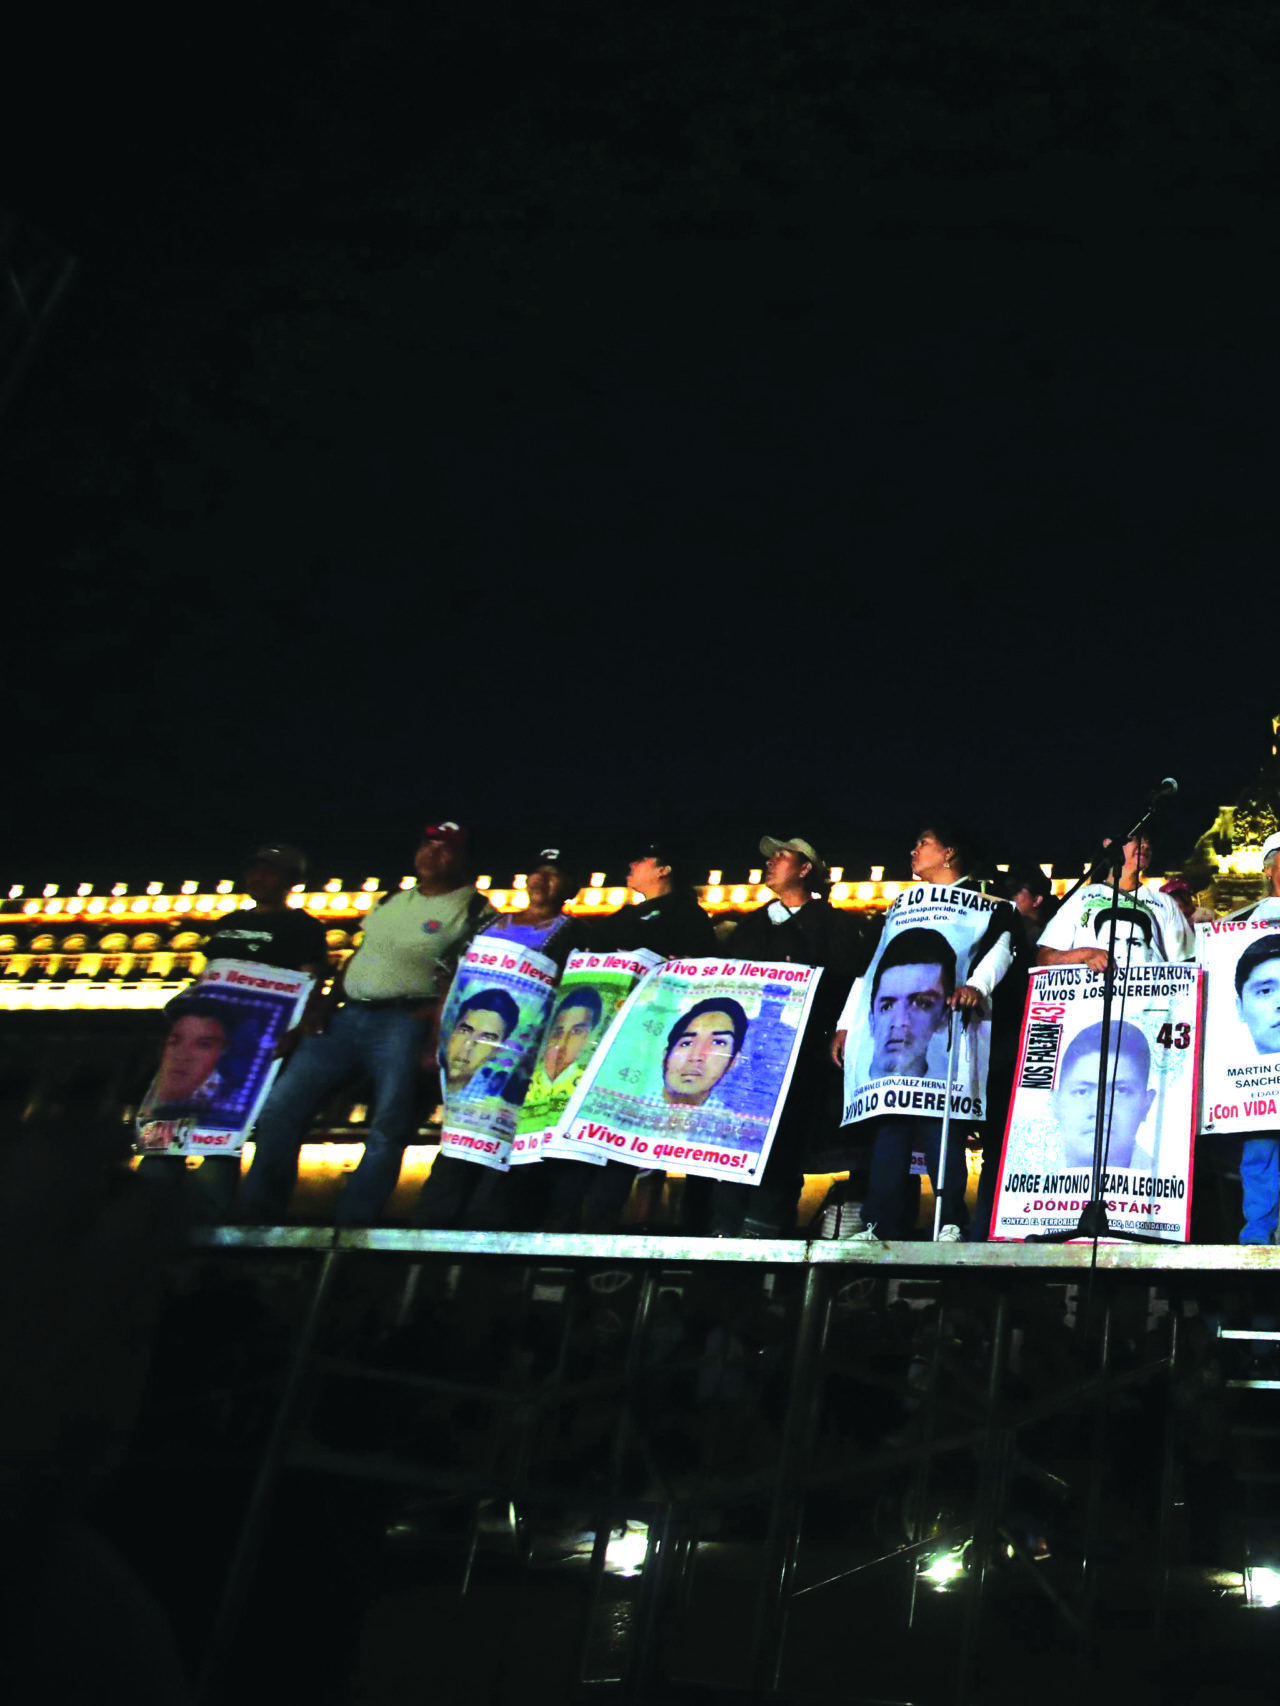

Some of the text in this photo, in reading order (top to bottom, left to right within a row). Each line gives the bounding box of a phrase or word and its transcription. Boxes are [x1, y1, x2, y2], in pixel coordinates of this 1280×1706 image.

[908, 888, 924, 906] LO
[958, 908, 967, 916] de
[1251, 919, 1269, 930] se
[480, 953, 497, 967] se
[501, 953, 516, 969] lo
[569, 959, 581, 968] se
[586, 956, 599, 967] lo
[701, 964, 717, 976] se
[721, 963, 736, 976] lo
[740, 963, 811, 983] llevaron!
[1129, 966, 1195, 983] LLEVARON,
[1039, 989, 1075, 1001] VIVOS
[1083, 985, 1105, 999] LOS
[1026, 1023, 1063, 1063] FALTAN
[1157, 1022, 1191, 1050] 43
[1021, 1064, 1055, 1090] NOS
[921, 1080, 964, 1092] HERNADEZ
[1251, 1090, 1279, 1099] EDAD
[845, 1089, 982, 1120] VIVO LO QUEREMOS
[1209, 1105, 1239, 1122] ¡Con
[1244, 1099, 1277, 1117] VIDA
[577, 1123, 627, 1147] ¡Vivo
[631, 1137, 648, 1153] lo
[653, 1144, 748, 1168] queremos!
[1005, 1173, 1041, 1193] JORGE
[1042, 1173, 1090, 1194] ANTONIO
[1133, 1175, 1185, 1199] LEGIDEÑO
[1104, 1199, 1161, 1215] STÁN?
[1000, 1216, 1029, 1226] CONTRA
[1030, 1217, 1040, 1226] EL
[1040, 1217, 1079, 1227] TERRORISM
[1125, 1220, 1135, 1229] LA
[1135, 1220, 1181, 1232] SOLIDARIDAD
